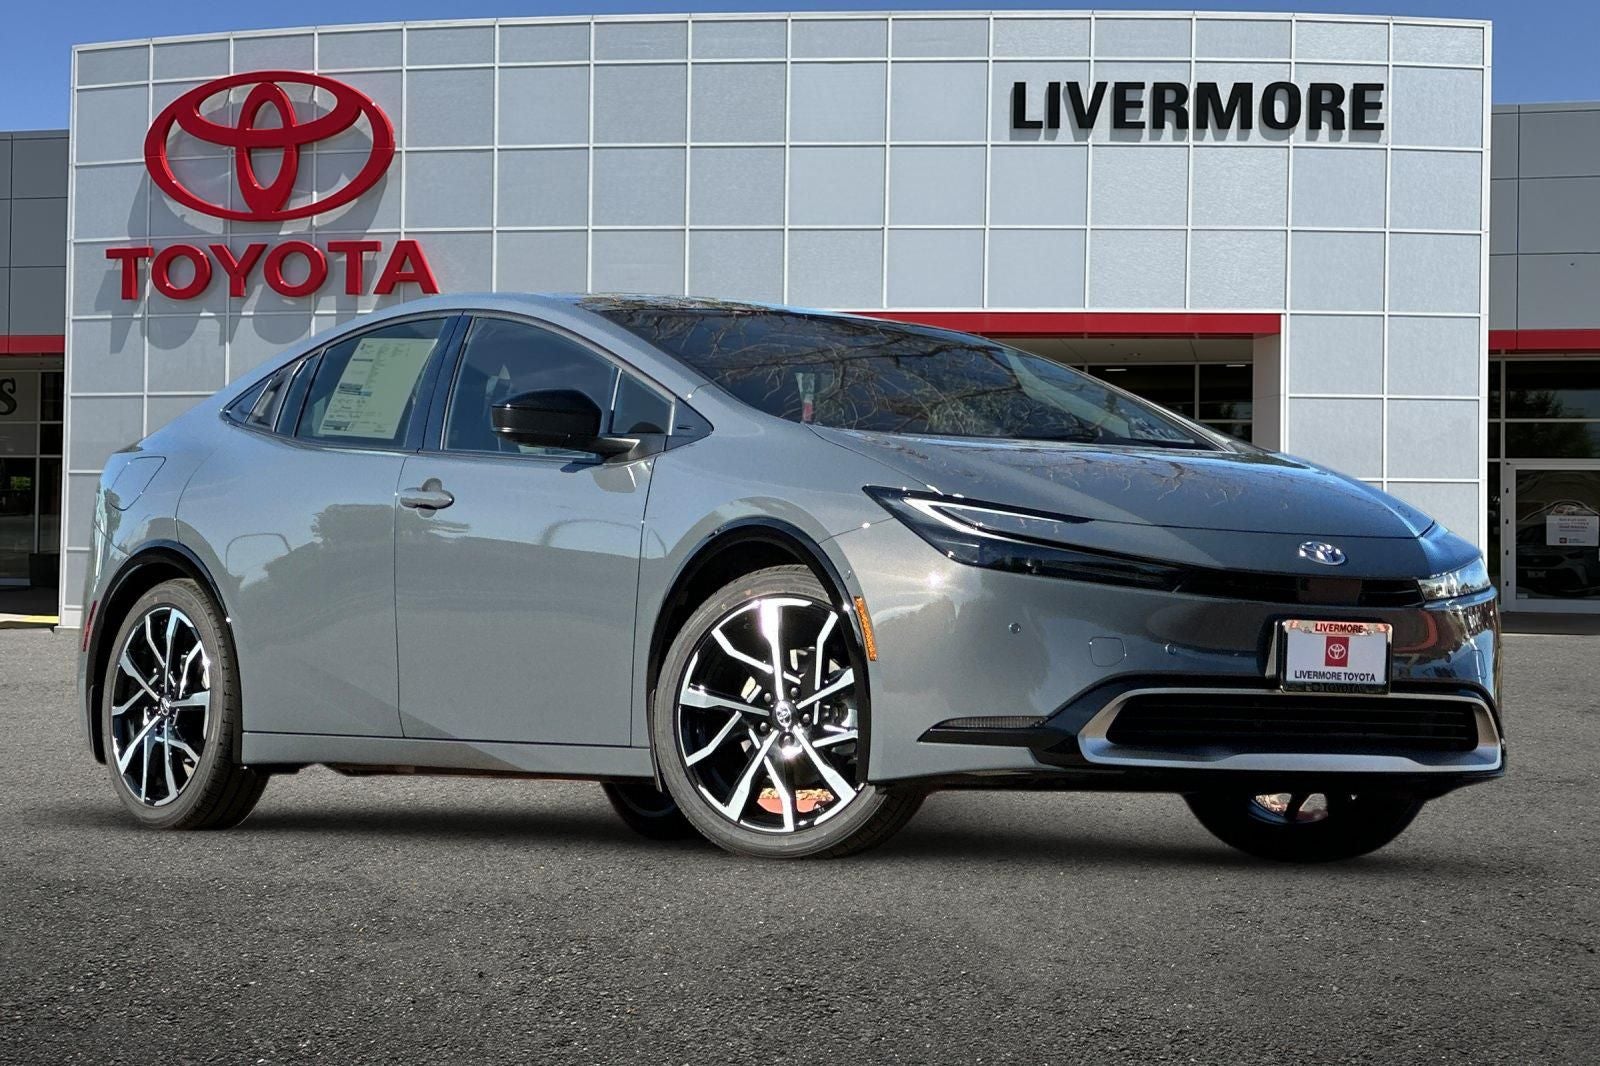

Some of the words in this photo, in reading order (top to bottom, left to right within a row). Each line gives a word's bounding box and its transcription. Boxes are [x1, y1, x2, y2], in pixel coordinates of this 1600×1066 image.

[1012, 81, 1385, 131] LIVERMORE
[106, 240, 440, 300] TOYOTA
[1315, 623, 1364, 633] LIVERMORE
[1295, 670, 1342, 680] LIVERMORE
[1343, 673, 1376, 682] TOYOTA
